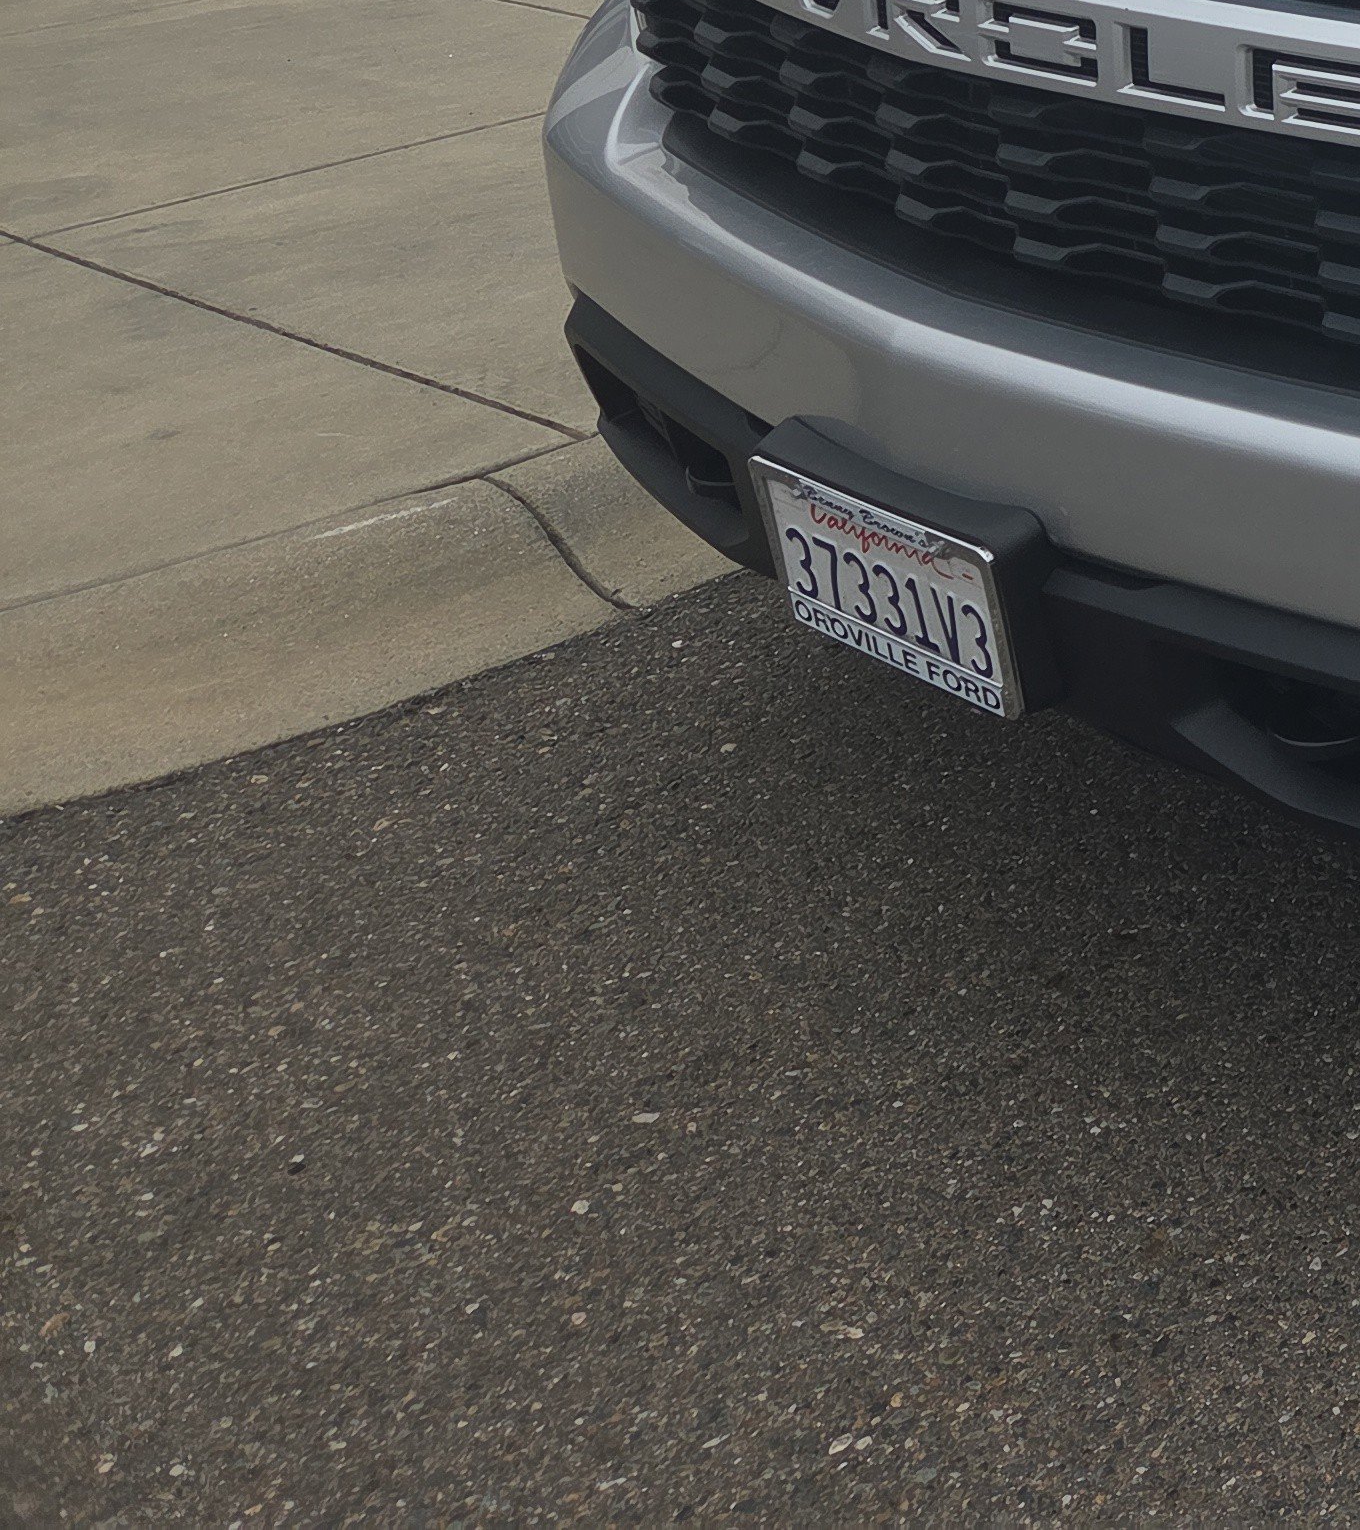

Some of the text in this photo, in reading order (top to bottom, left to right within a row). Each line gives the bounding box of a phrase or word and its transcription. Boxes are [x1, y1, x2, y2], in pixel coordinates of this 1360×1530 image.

[785, 527, 994, 679] 37331V3
[795, 600, 1001, 710] OROVILLE FORD
